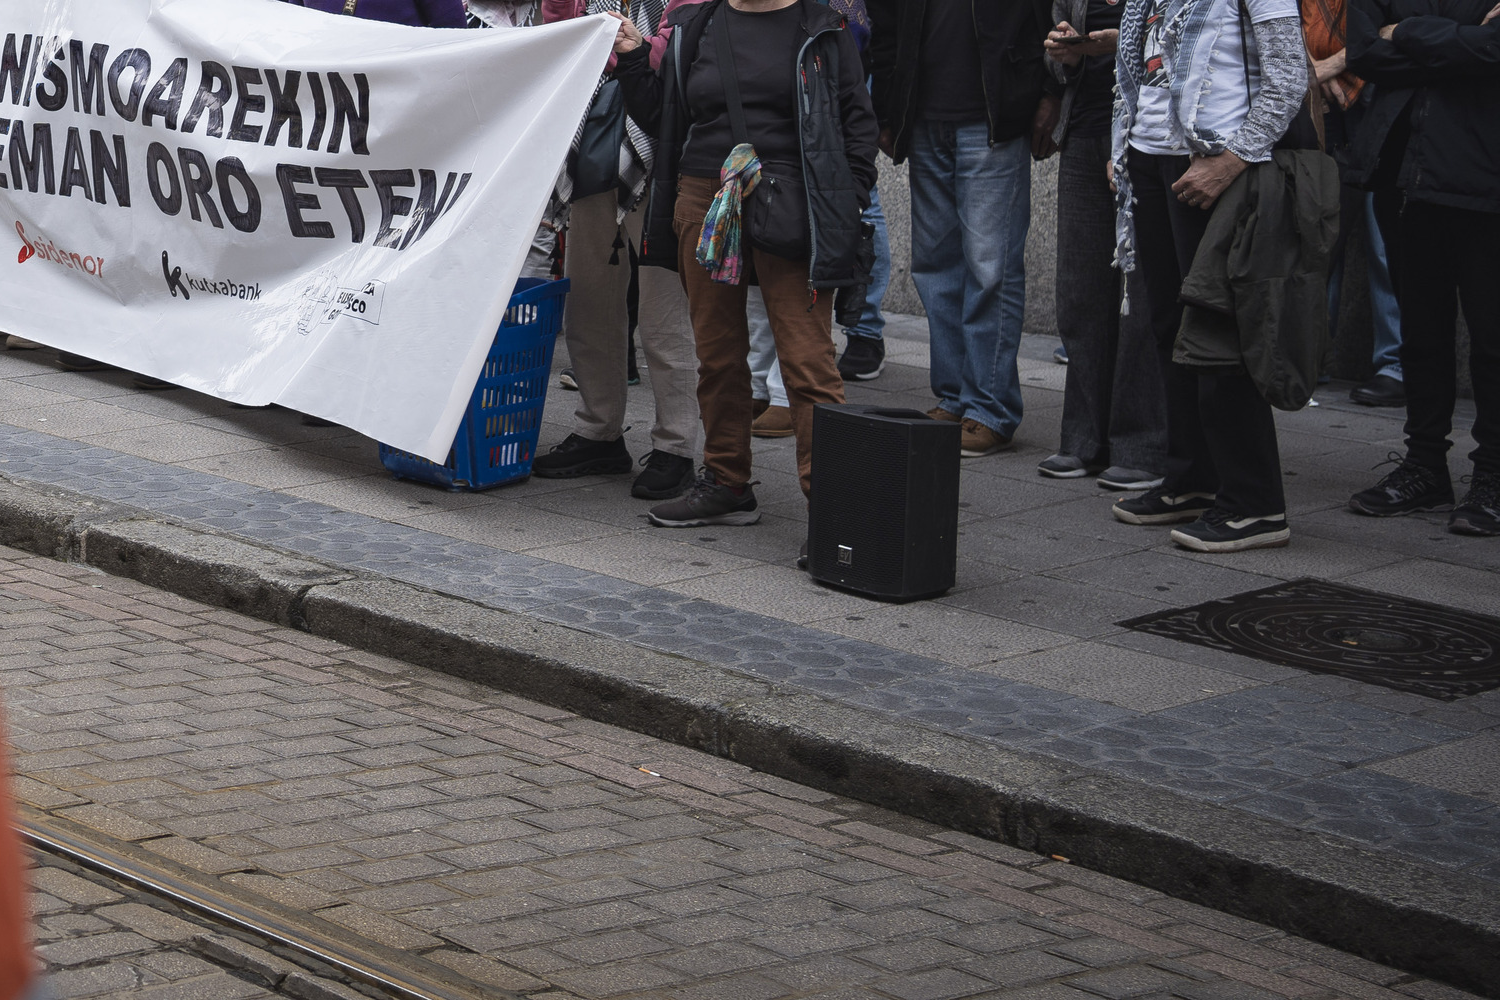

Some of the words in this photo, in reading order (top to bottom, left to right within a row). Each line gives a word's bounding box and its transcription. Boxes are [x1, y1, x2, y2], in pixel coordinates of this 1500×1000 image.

[146, 142, 262, 233] ORO
[34, 236, 105, 278] sidenor
[185, 273, 262, 301] kutxabank
